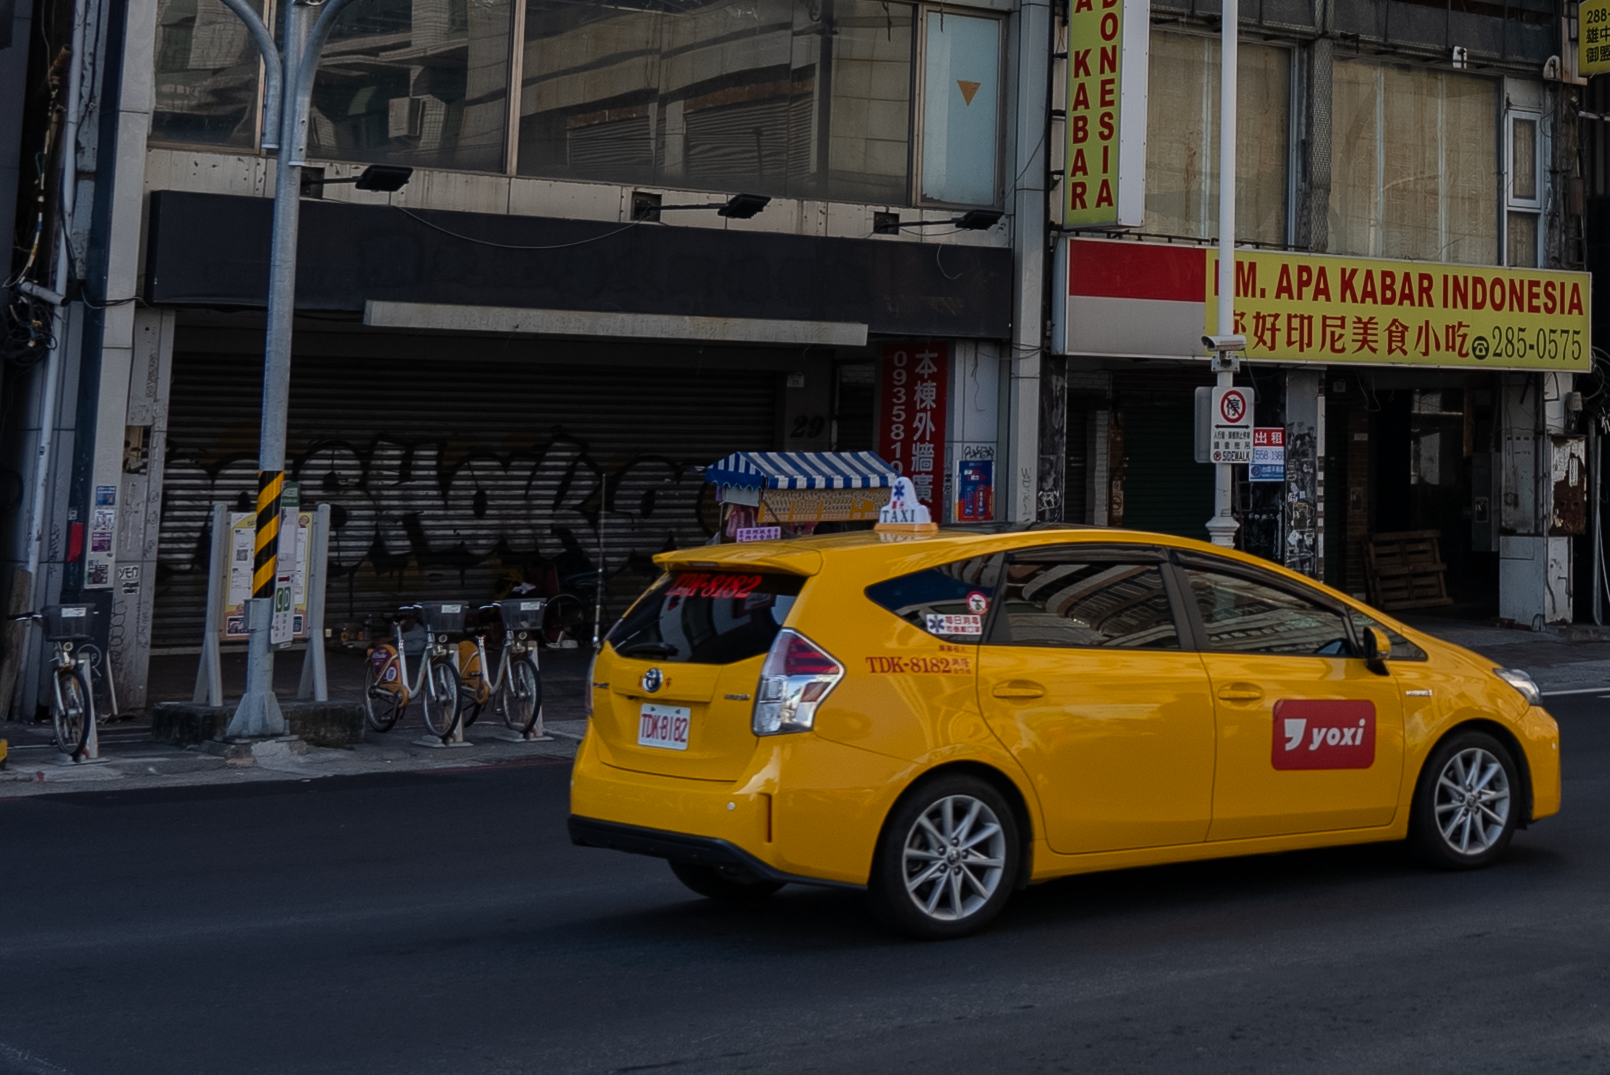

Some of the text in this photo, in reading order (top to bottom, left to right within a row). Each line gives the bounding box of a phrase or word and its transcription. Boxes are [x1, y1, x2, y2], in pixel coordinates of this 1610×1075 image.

[1070, 50, 1092, 211] KABAR
[1274, 264, 1332, 303] APA
[1339, 267, 1434, 309] KABAR
[1442, 273, 1584, 317] INDONESIA
[1492, 325, 1582, 362] 285-0575
[790, 415, 825, 439] 29
[911, 349, 939, 506] 本棟外牆廣
[1254, 431, 1283, 445] 出租
[1222, 451, 1250, 462] SIDEWALK
[882, 509, 915, 523] TAXI
[865, 656, 951, 674] TDK-8182
[641, 713, 688, 743] TDK-8182
[1308, 718, 1366, 751] yoxi
